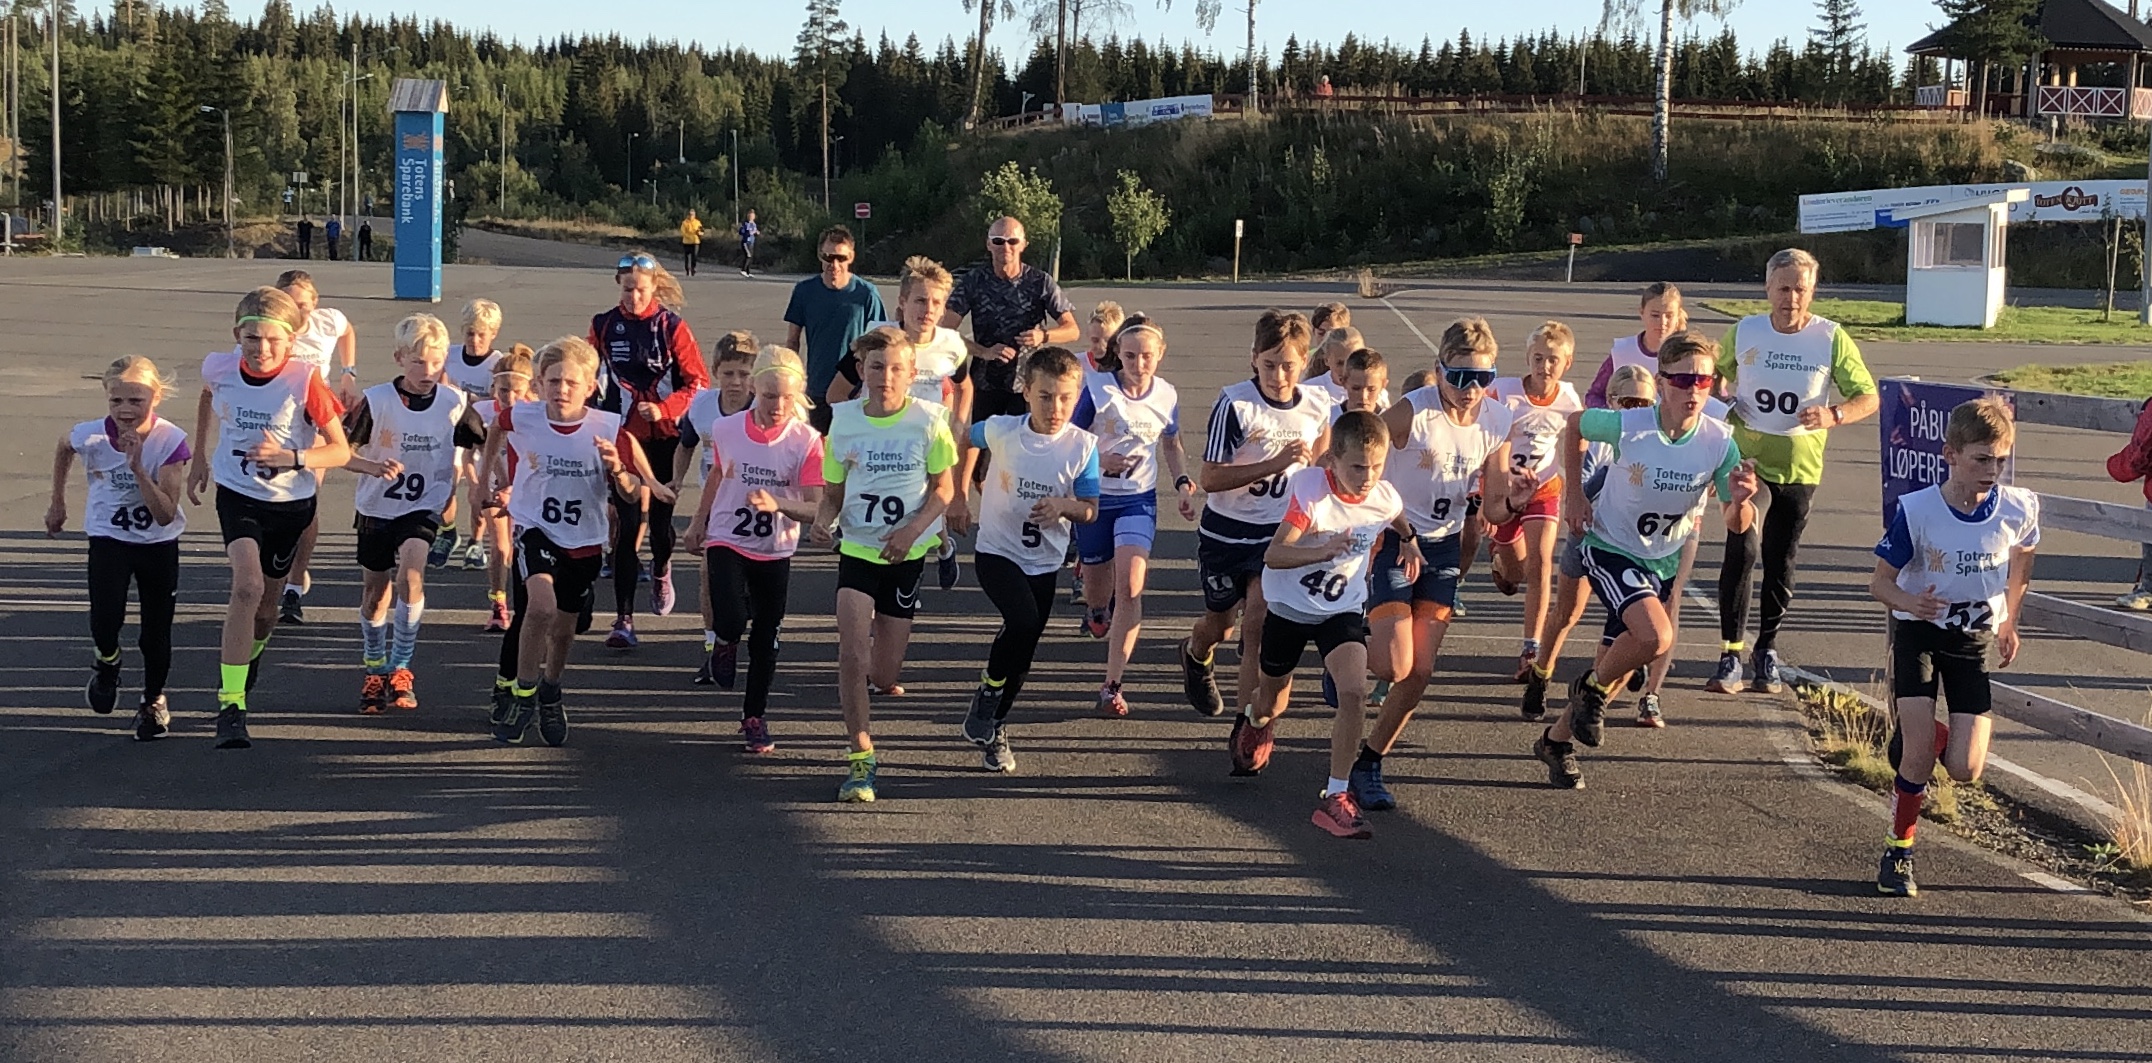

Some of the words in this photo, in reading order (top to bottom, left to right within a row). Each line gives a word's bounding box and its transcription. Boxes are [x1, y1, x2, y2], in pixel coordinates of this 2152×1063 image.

[399, 158, 415, 224] Sparebank
[414, 158, 428, 201] Totens
[1767, 351, 1802, 362] Totens
[236, 407, 272, 420] Totens
[1755, 388, 1799, 415] 90
[546, 455, 583, 468] Totens
[867, 451, 903, 461] Totens
[110, 470, 133, 480] Tote
[742, 462, 777, 477] Totens
[1656, 467, 1693, 482] Totens
[383, 472, 425, 501] 29
[1018, 476, 1053, 493] Totens
[111, 505, 153, 531] 49
[542, 497, 582, 526] 65
[732, 507, 773, 537] 28
[860, 493, 904, 525] 79
[1637, 512, 1683, 536] 67
[1299, 569, 1347, 602] 40
[1944, 600, 1993, 632] 52
